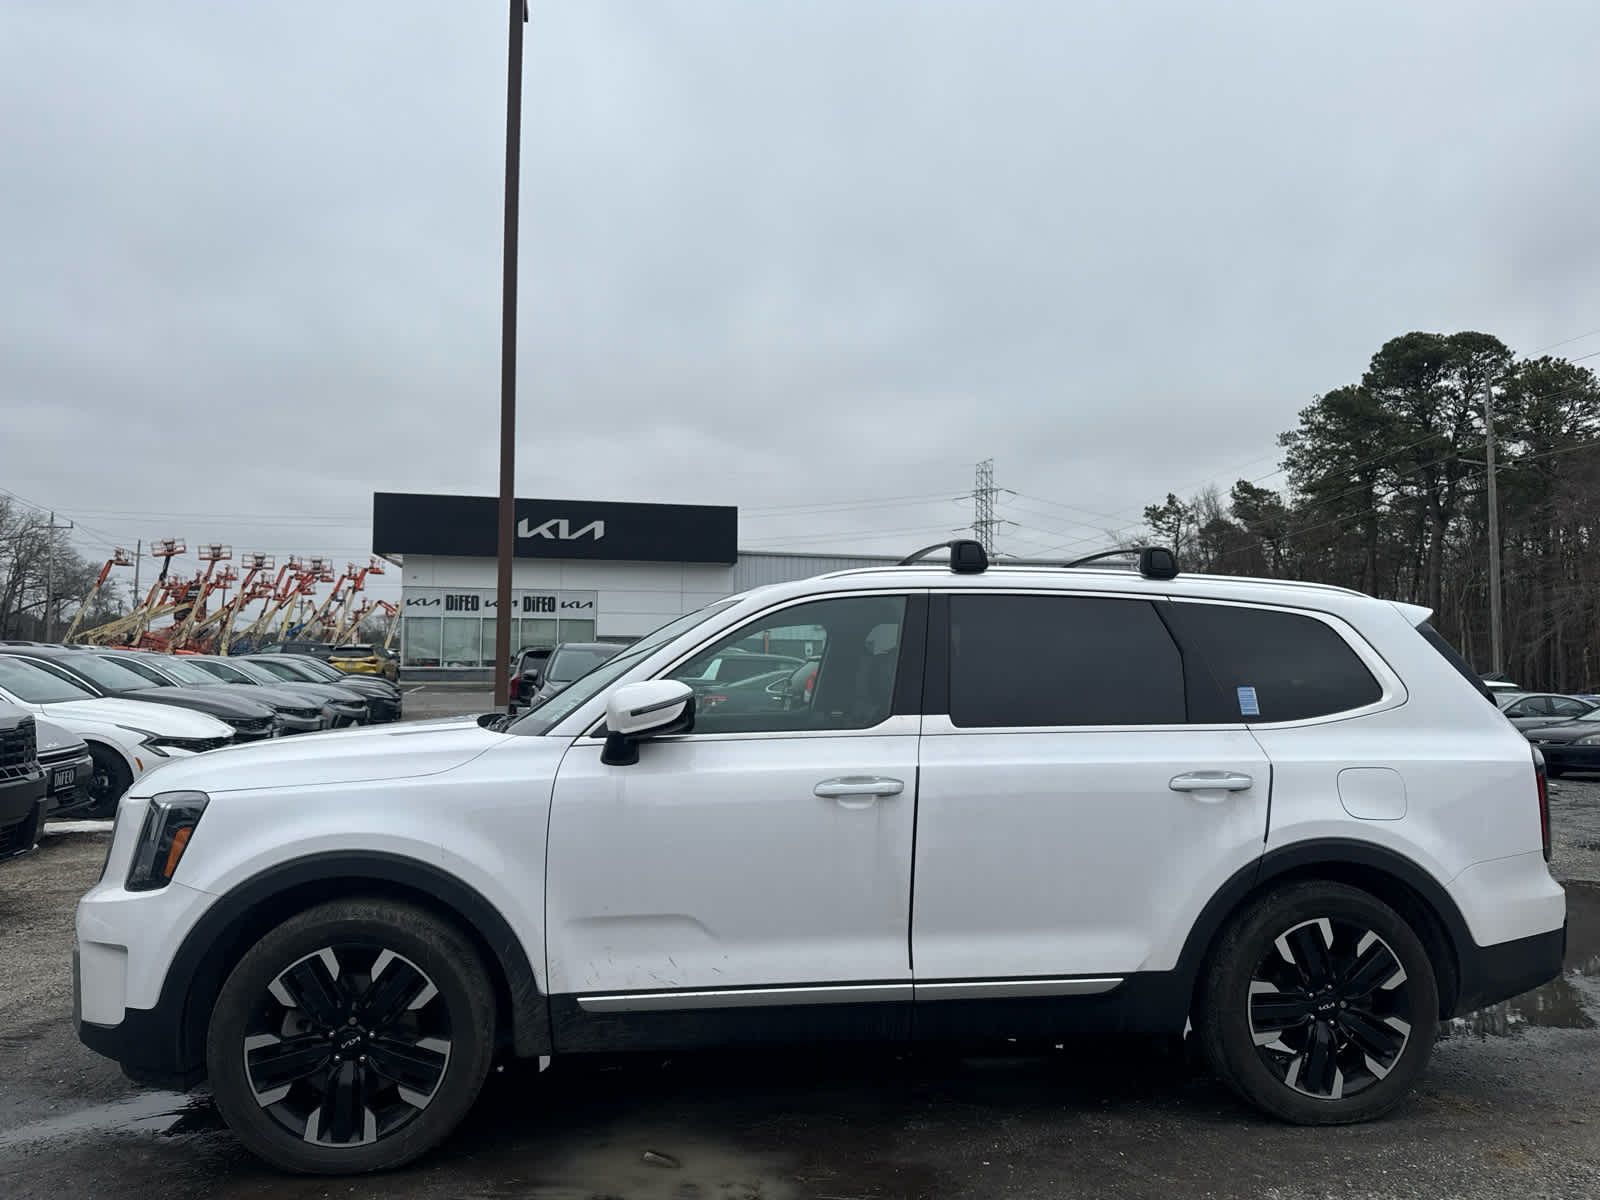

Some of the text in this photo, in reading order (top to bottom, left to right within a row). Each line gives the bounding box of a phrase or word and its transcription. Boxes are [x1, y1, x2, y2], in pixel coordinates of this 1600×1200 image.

[517, 517, 605, 541] KIA
[406, 598, 441, 607] KIA
[561, 600, 594, 609] KIA
